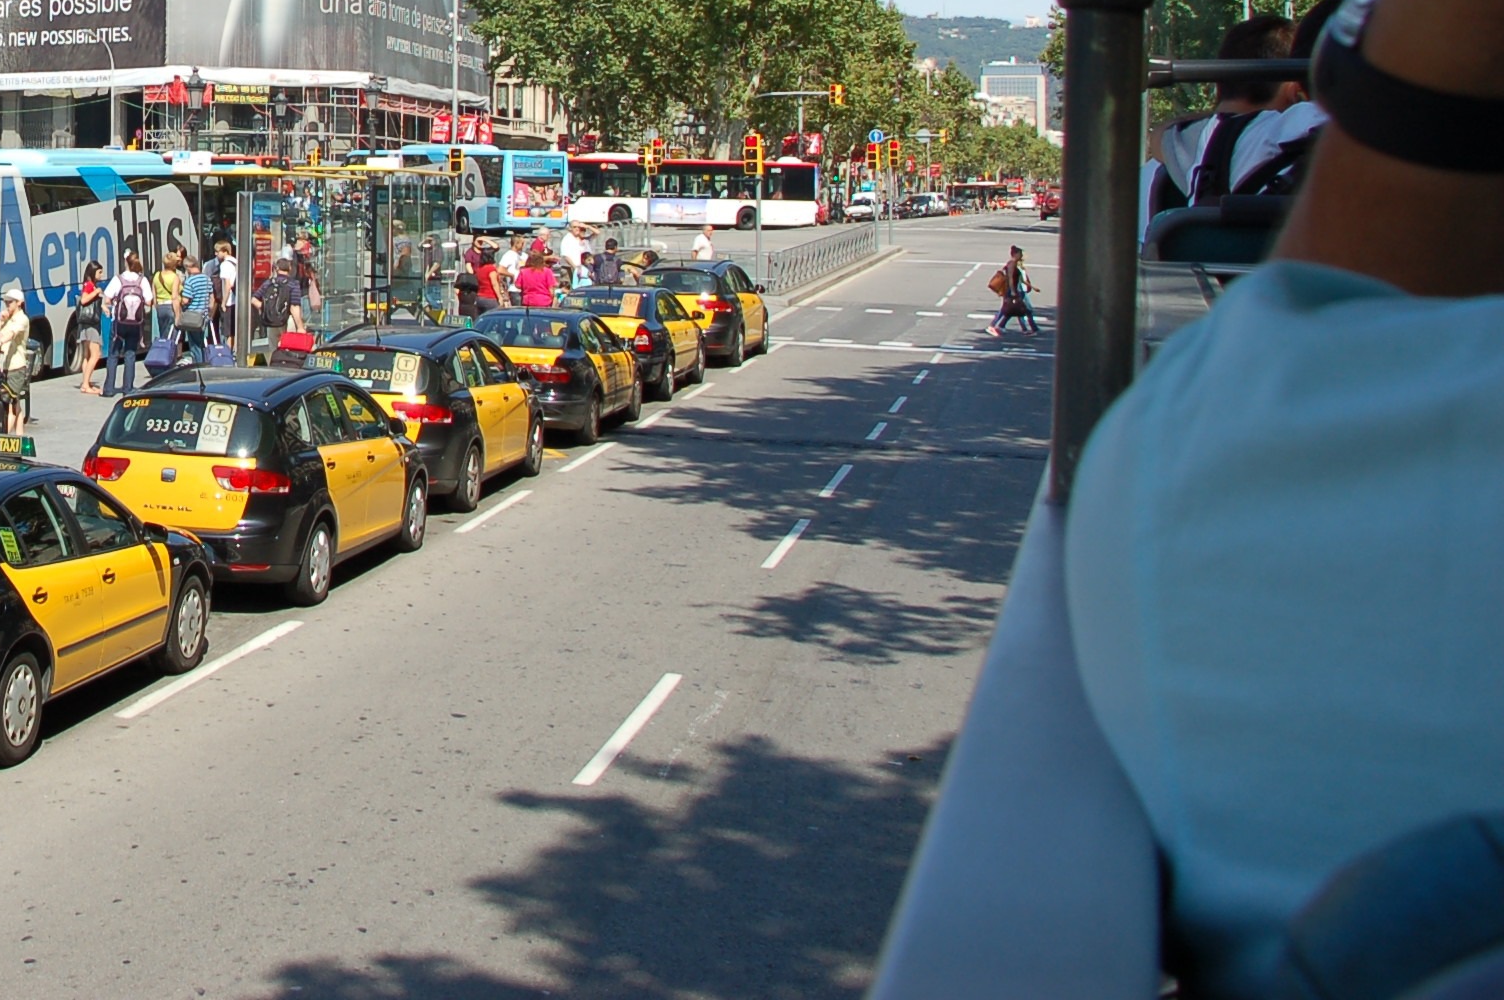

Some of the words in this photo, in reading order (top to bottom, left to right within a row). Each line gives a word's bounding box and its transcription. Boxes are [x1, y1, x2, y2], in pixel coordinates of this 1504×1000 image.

[411, 4, 421, 29] de
[8, 31, 38, 48] NEW
[41, 26, 133, 46] POSSIBILITIES.
[316, 356, 333, 369] TAXI
[348, 367, 368, 379] 933
[371, 370, 392, 381] 033
[394, 371, 415, 383] 033
[216, 408, 226, 419] T
[146, 418, 170, 433] 933
[173, 420, 199, 435] 033
[203, 424, 228, 438] 033
